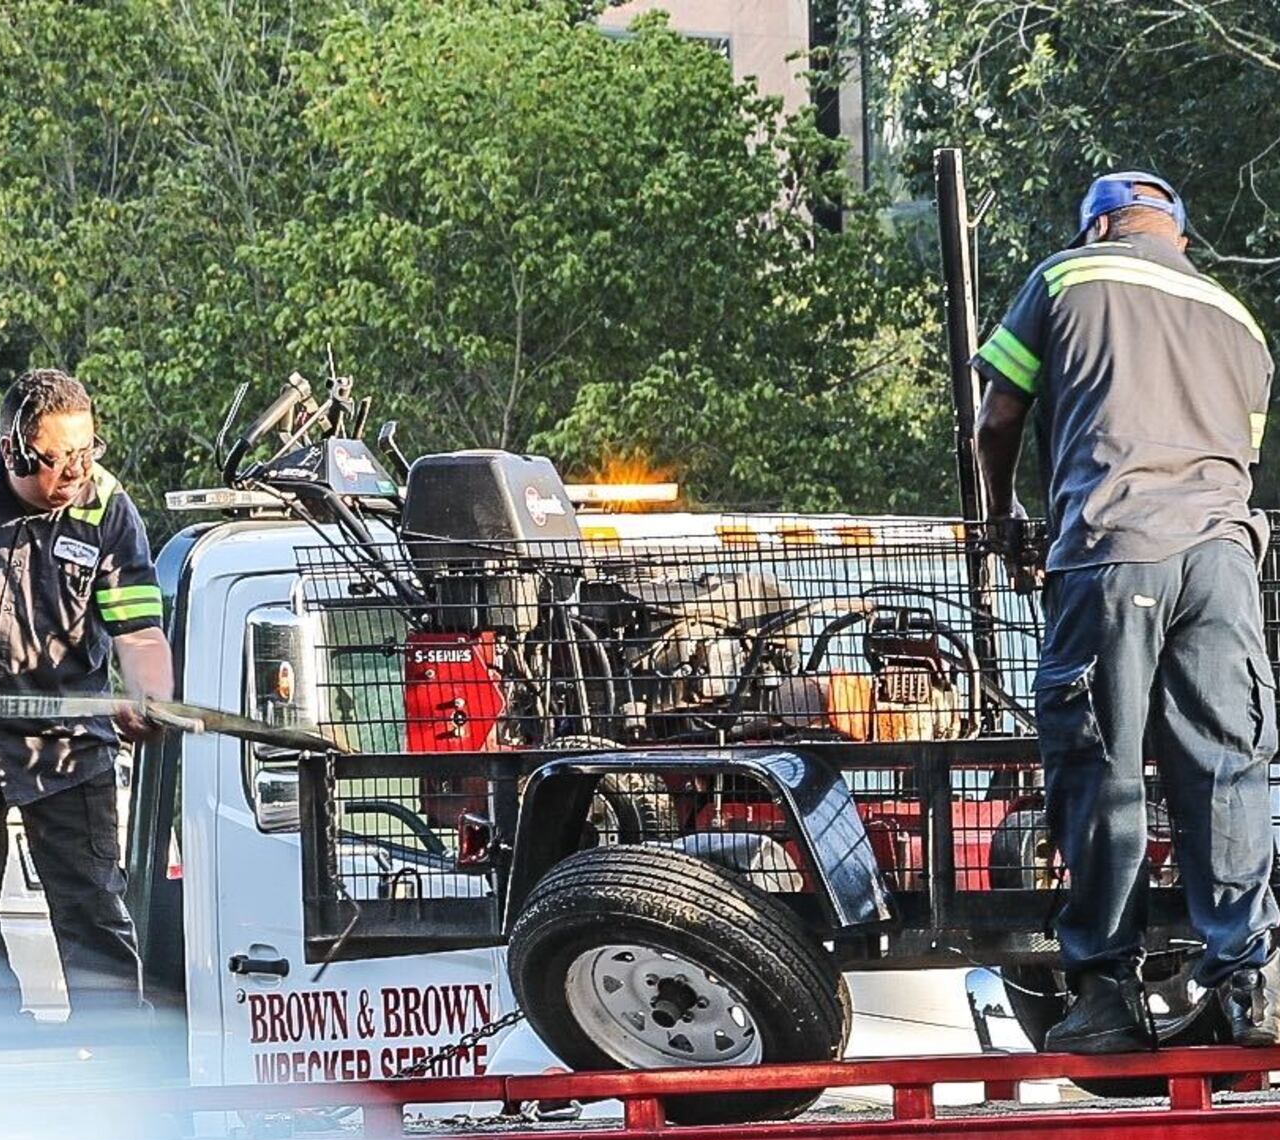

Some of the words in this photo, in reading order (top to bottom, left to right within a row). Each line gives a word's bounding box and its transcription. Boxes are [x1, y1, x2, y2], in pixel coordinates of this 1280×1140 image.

[249, 990, 348, 1043] BROWN
[357, 990, 375, 1039] &
[381, 984, 492, 1038] BROWN
